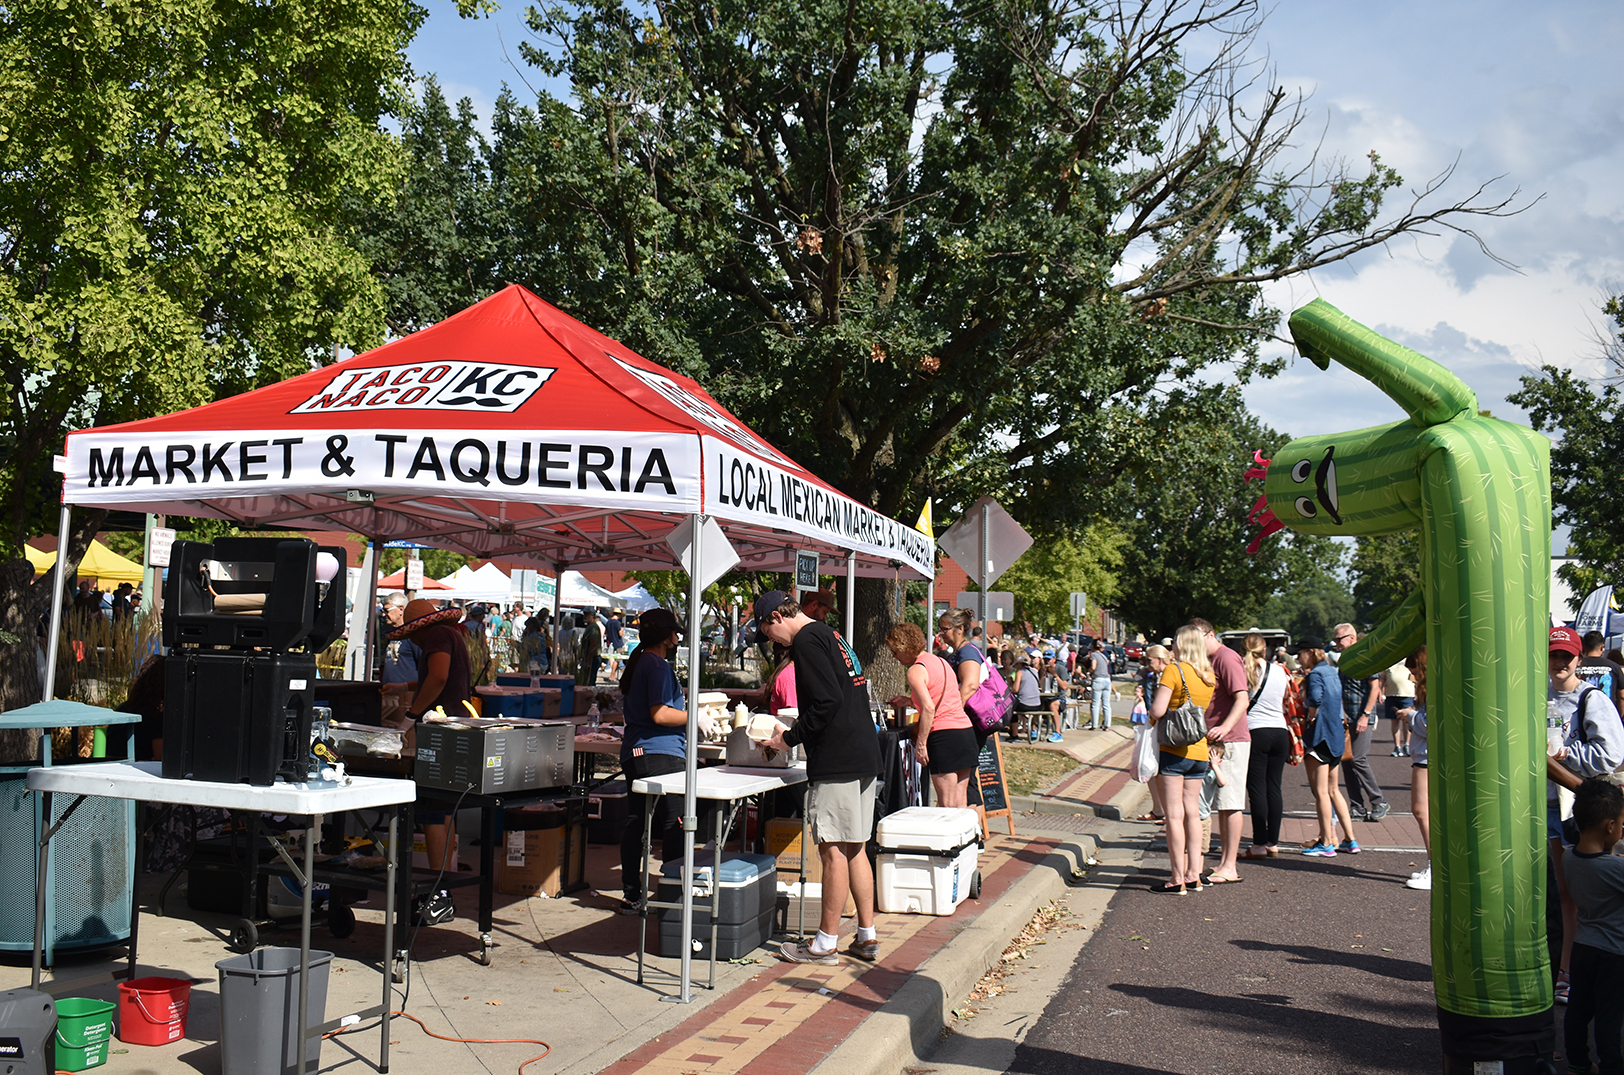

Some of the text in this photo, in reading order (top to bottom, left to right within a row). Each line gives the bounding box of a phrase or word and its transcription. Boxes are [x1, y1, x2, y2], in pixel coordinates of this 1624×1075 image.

[306, 386, 431, 409] NACO
[340, 365, 539, 396] TACO KC
[87, 434, 677, 495] MARKET & TAQUERIA
[719, 453, 778, 515] LOCAL
[780, 473, 842, 535] MEXICAN
[843, 501, 886, 547] MARKET
[886, 518, 895, 549] &
